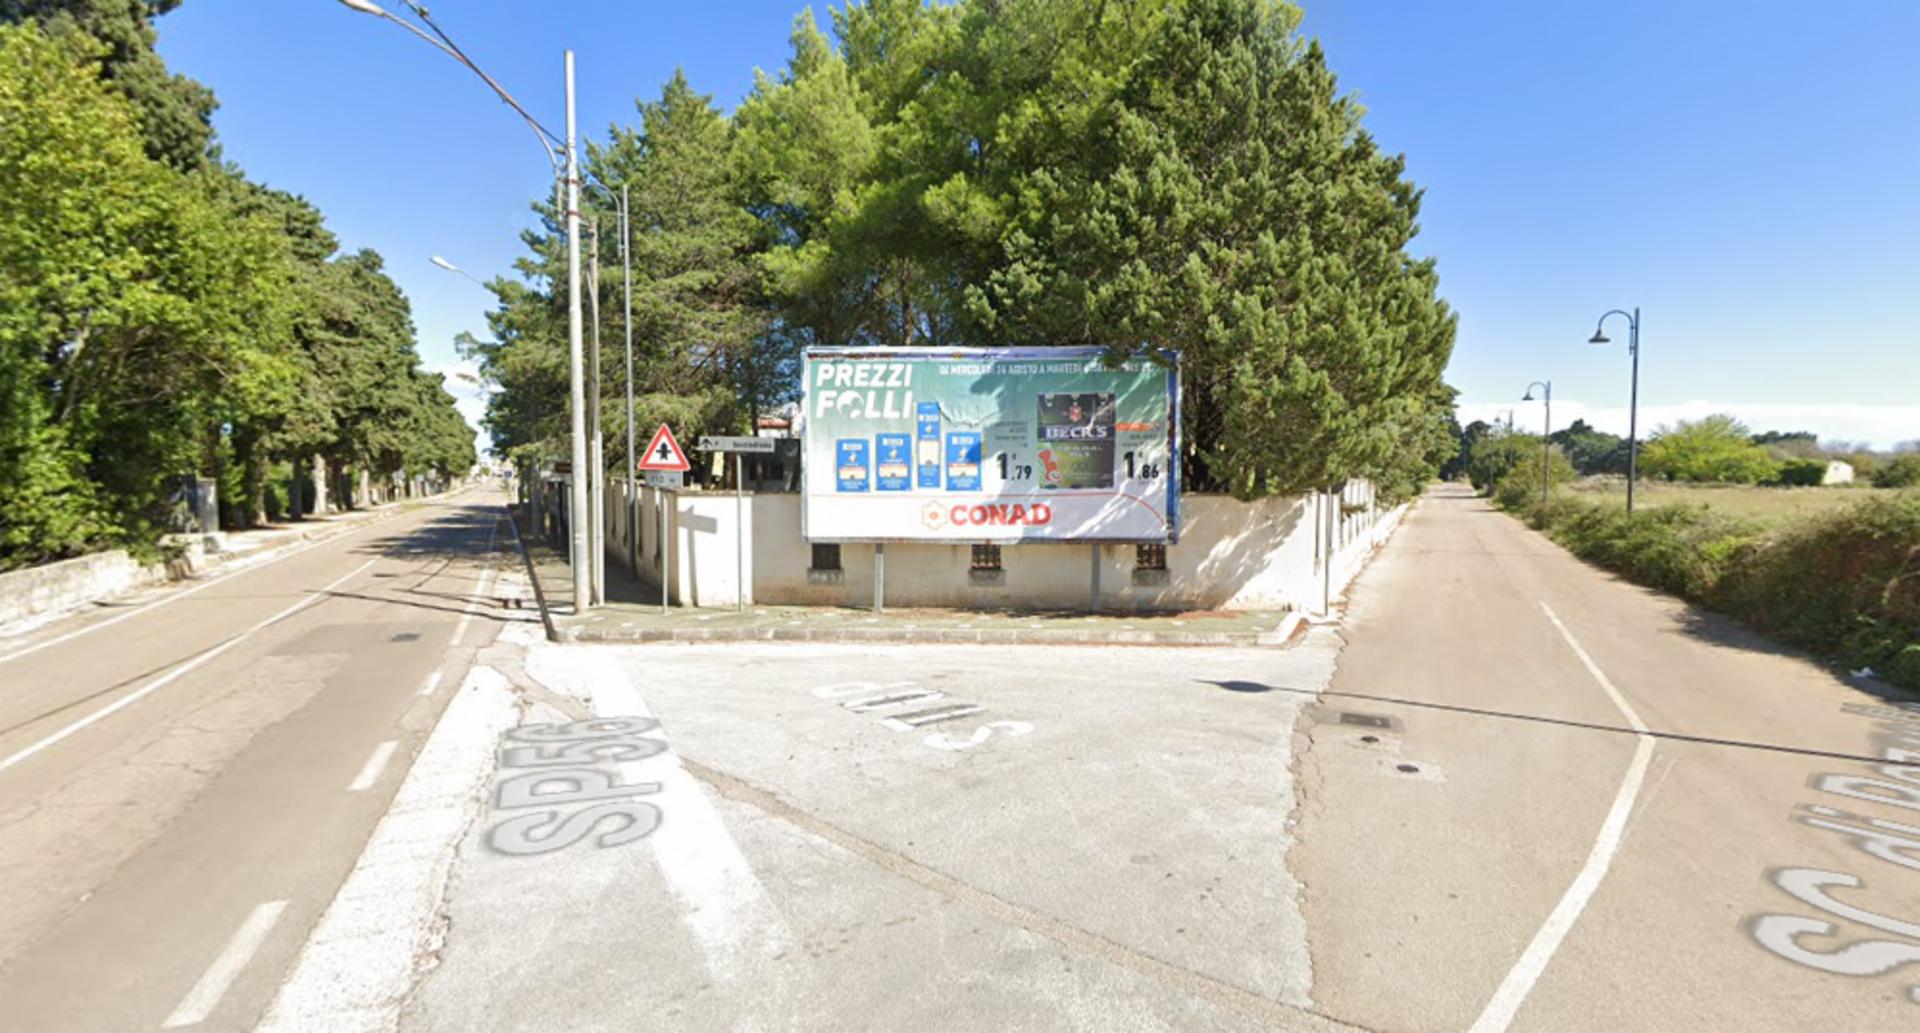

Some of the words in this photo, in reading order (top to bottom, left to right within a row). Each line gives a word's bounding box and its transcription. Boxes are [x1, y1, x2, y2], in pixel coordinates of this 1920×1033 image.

[816, 363, 913, 388] PREZZI
[816, 390, 913, 419] FOLLI
[949, 503, 1053, 526] CONAD
